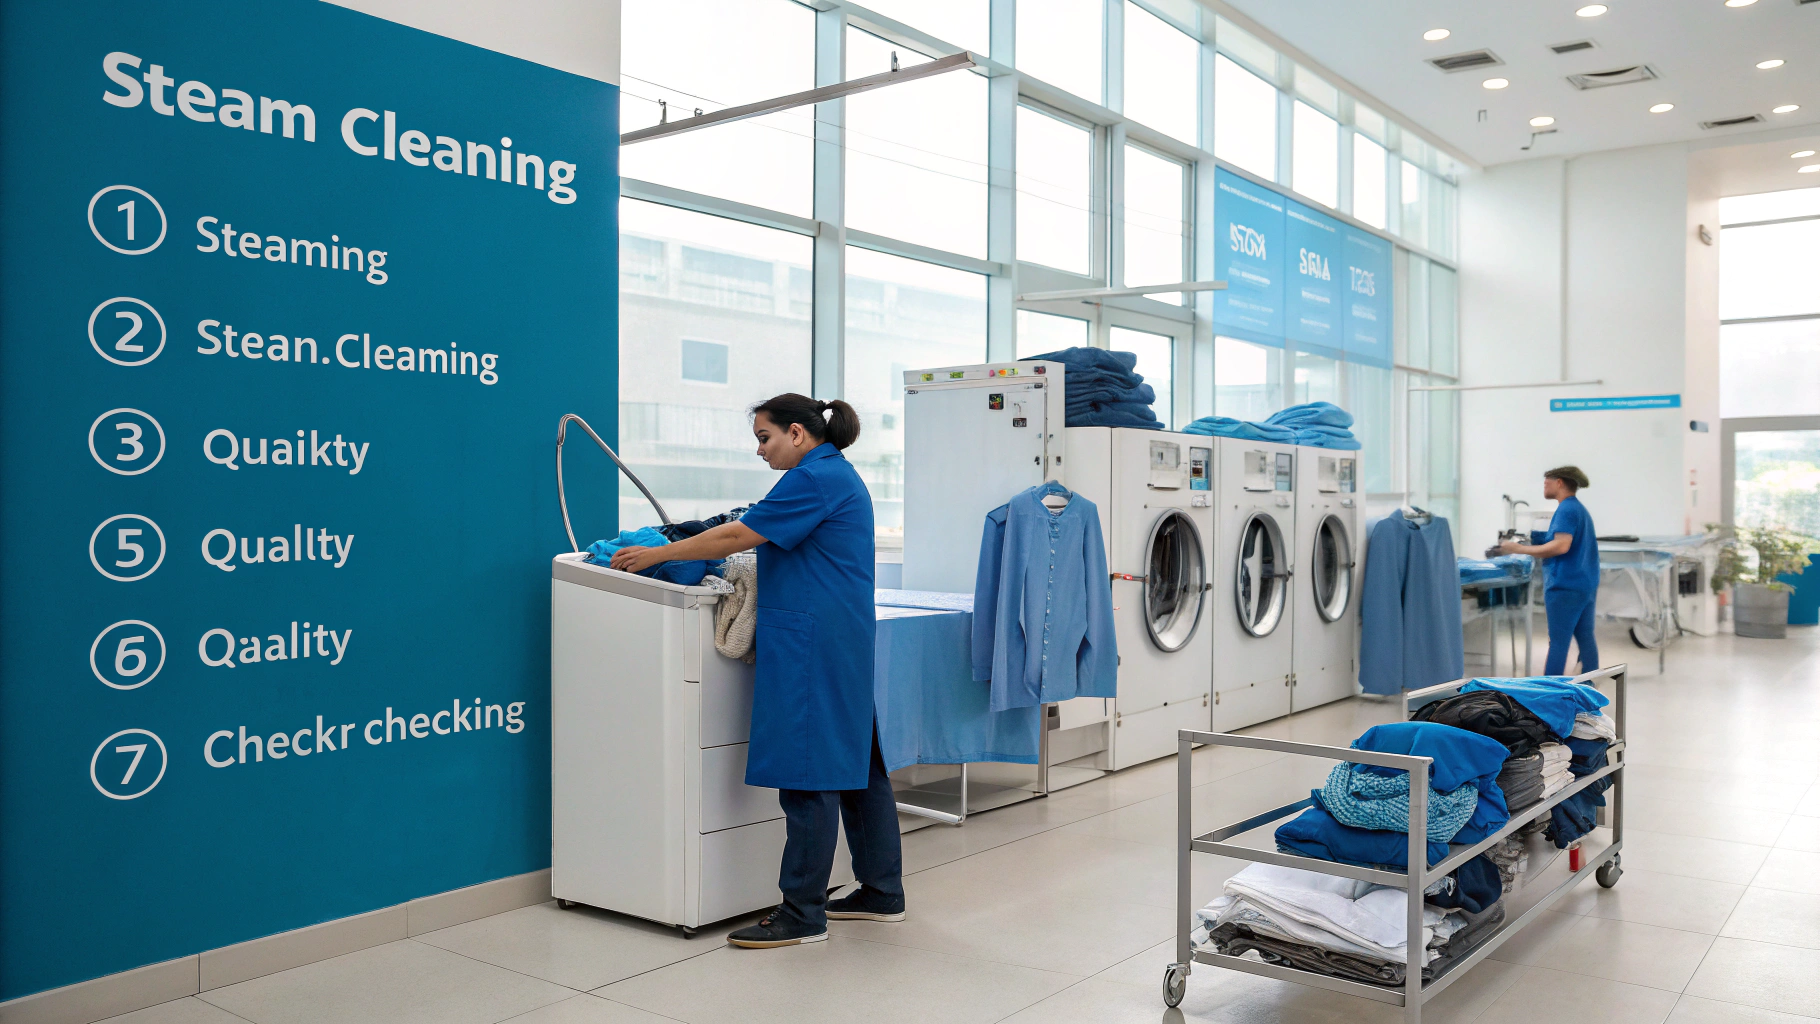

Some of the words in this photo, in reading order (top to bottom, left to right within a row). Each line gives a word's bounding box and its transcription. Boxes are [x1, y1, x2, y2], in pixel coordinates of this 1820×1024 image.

[102, 51, 316, 143] Steam
[340, 107, 578, 205] Cleaning
[117, 200, 136, 241] 1
[196, 215, 389, 286] Steaming
[114, 311, 145, 353] 2
[114, 422, 145, 462] 3
[203, 428, 370, 476] Quaikty
[114, 528, 145, 568] 5
[114, 635, 147, 677] 6
[114, 743, 148, 785] 7
[203, 715, 356, 769] Checkr
[363, 697, 527, 747] checking
